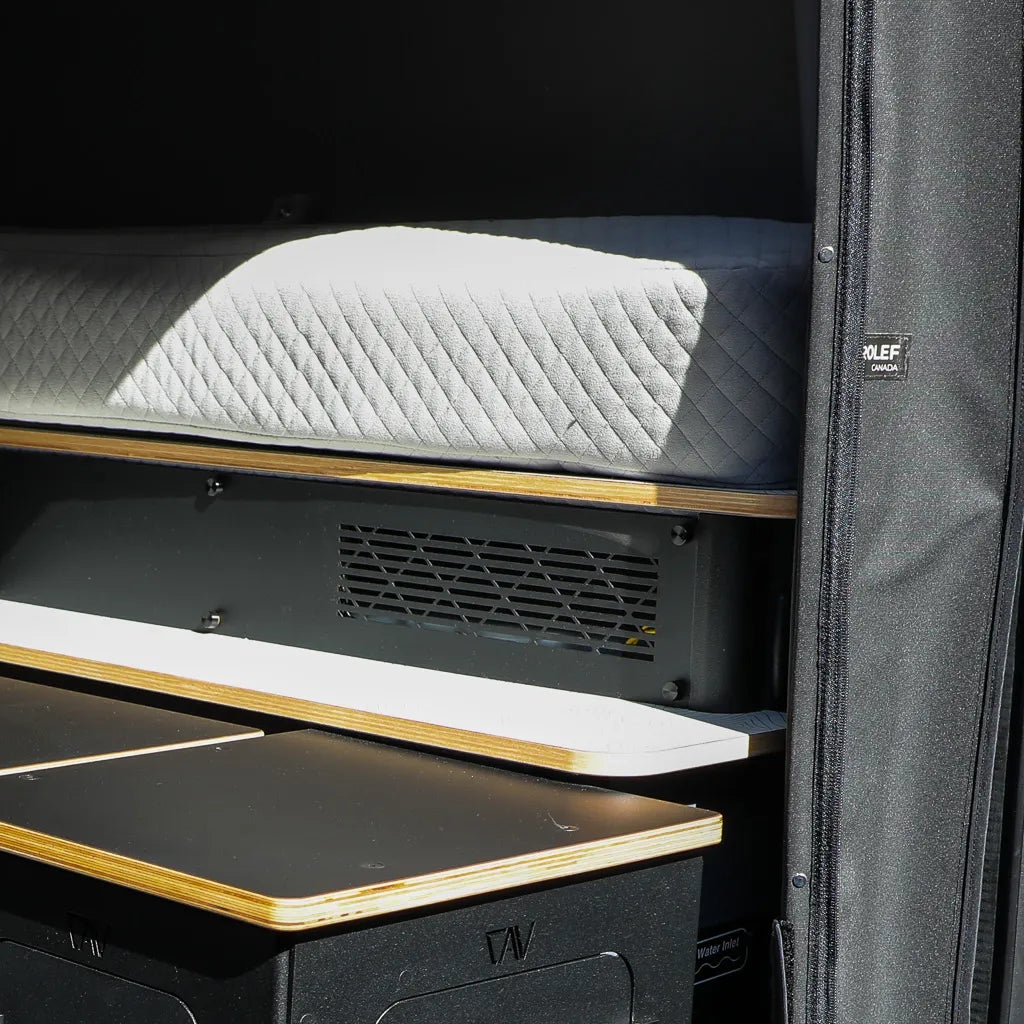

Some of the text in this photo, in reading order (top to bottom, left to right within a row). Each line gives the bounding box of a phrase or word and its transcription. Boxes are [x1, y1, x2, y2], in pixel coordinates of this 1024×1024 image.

[871, 363, 898, 372] CANADA
[697, 937, 741, 960] Water Inlet
